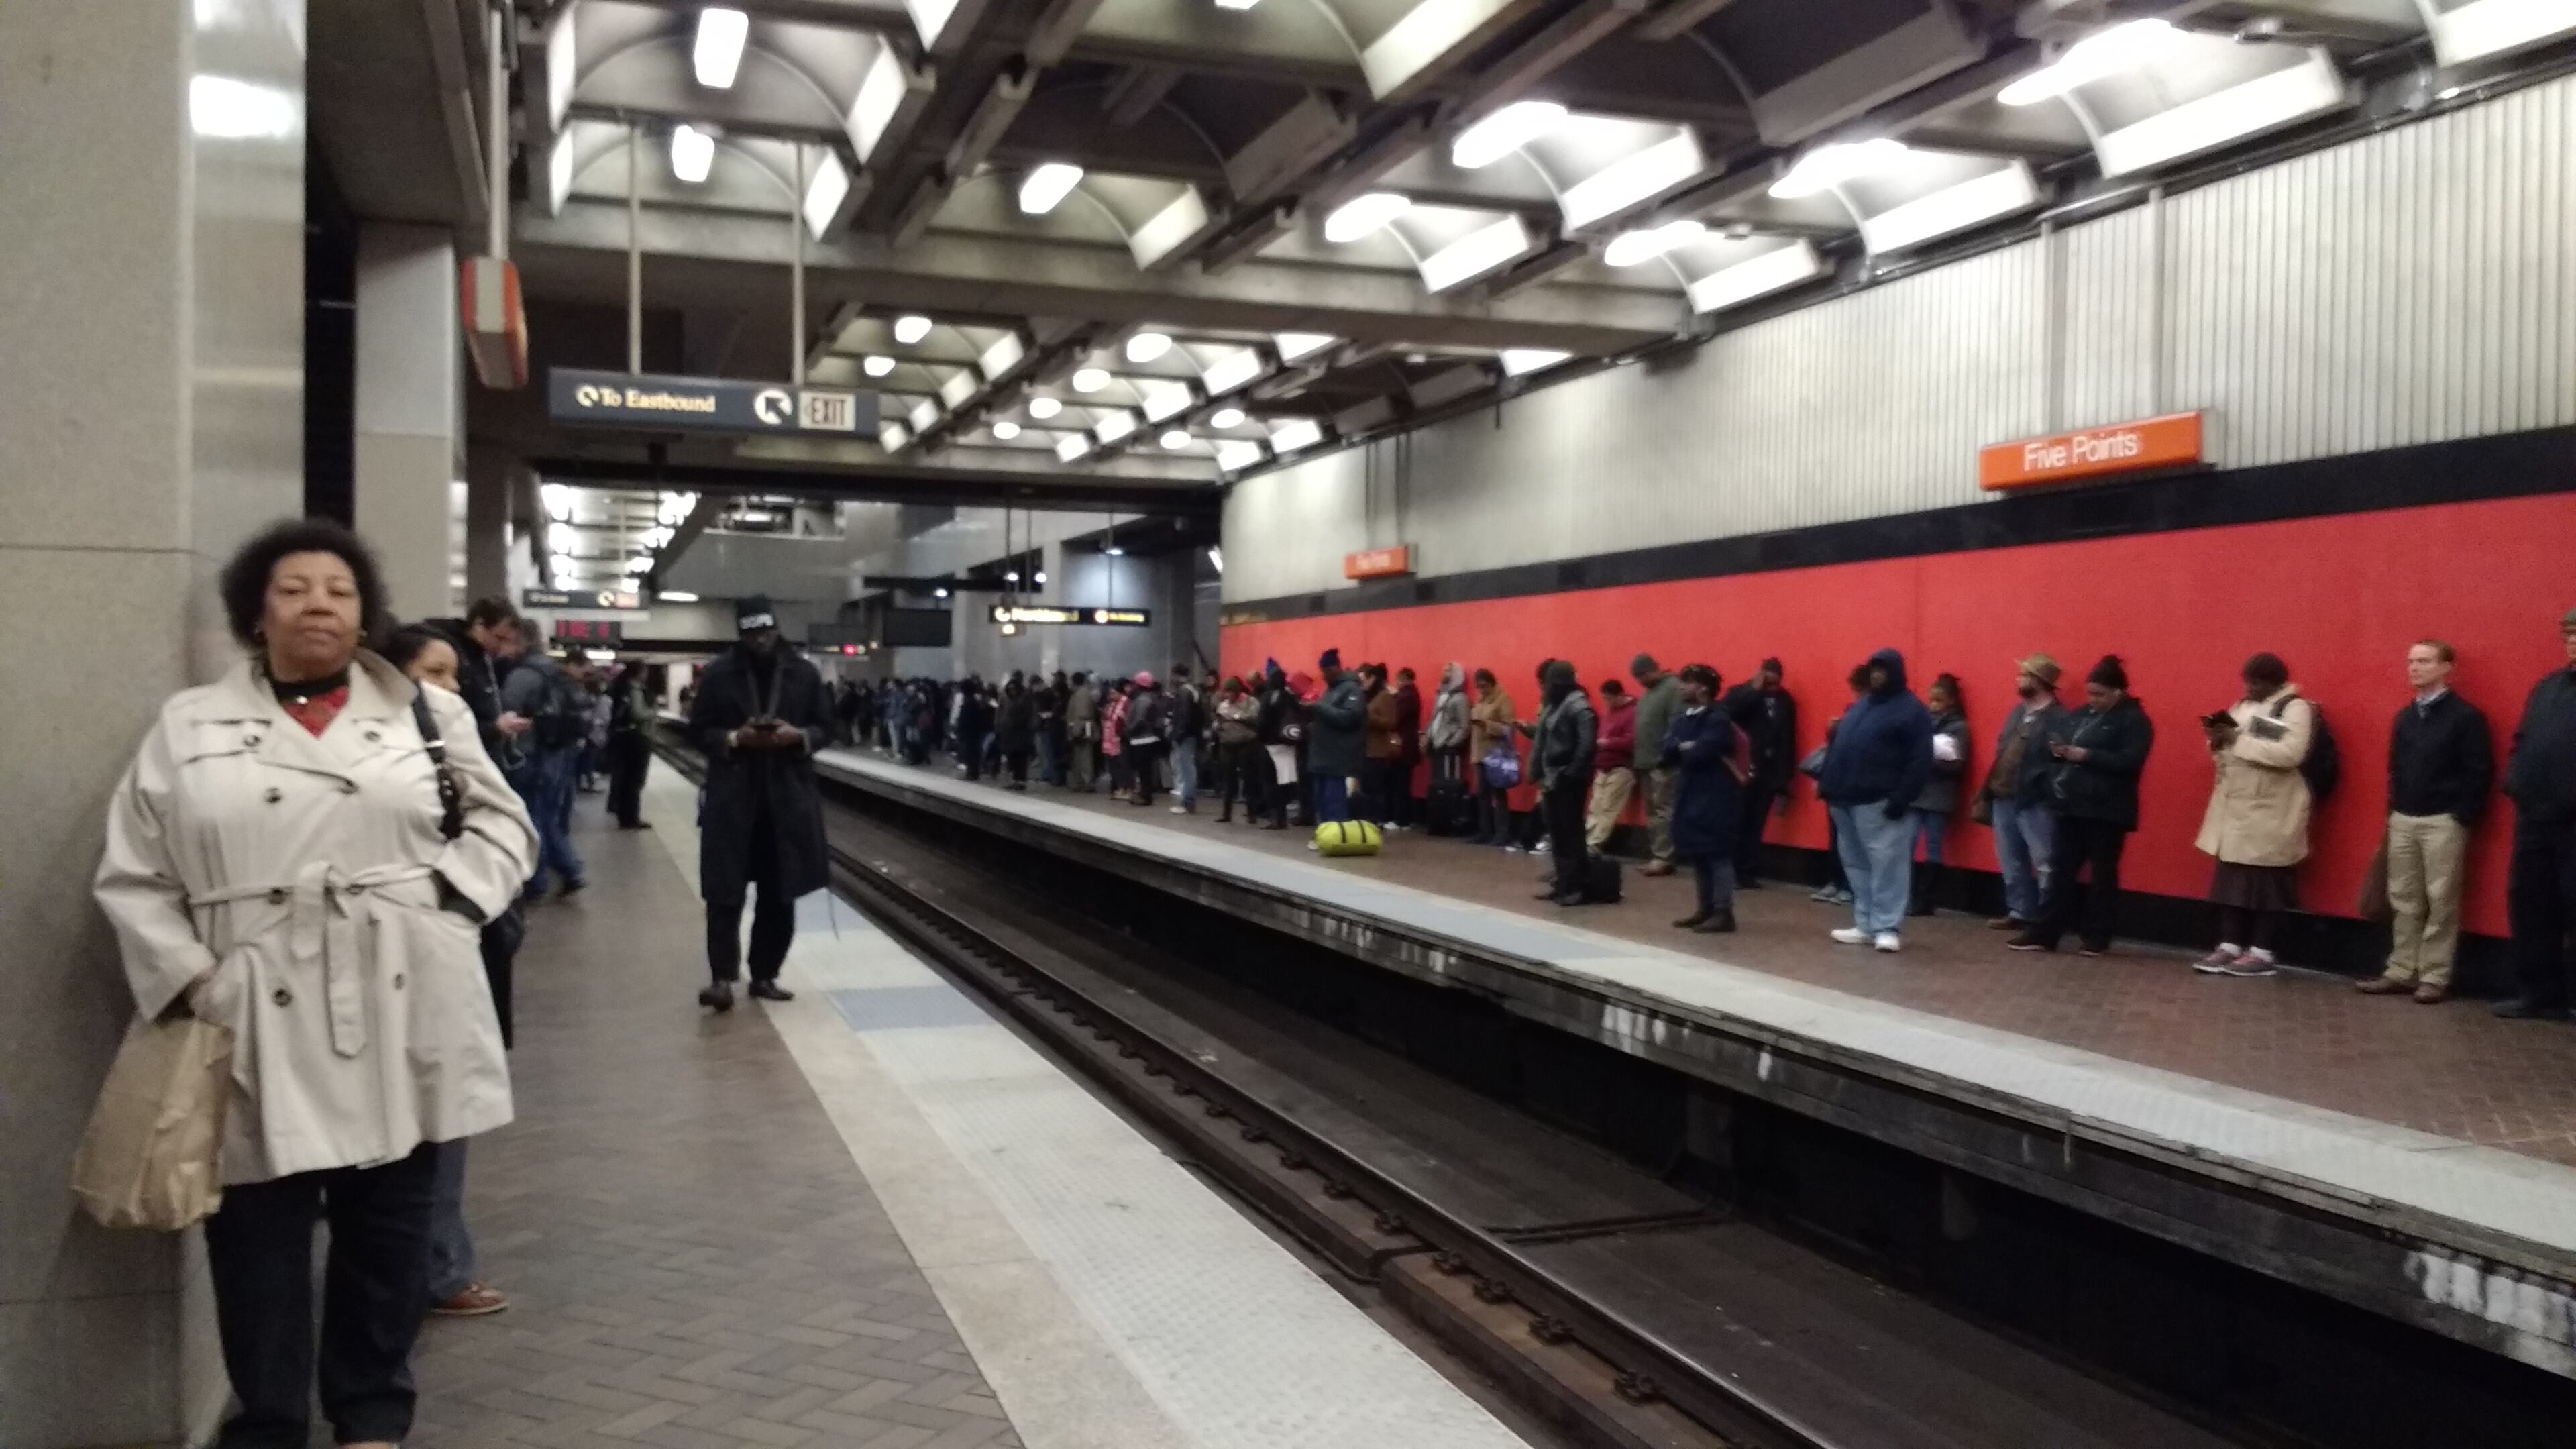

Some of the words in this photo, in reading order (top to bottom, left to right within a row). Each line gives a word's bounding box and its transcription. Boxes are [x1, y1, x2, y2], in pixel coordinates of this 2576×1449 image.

[600, 386, 623, 407] To
[625, 387, 716, 413] Eastbound
[810, 396, 846, 425] EXIT
[2024, 443, 2066, 472] Five
[2072, 431, 2139, 464] Points
